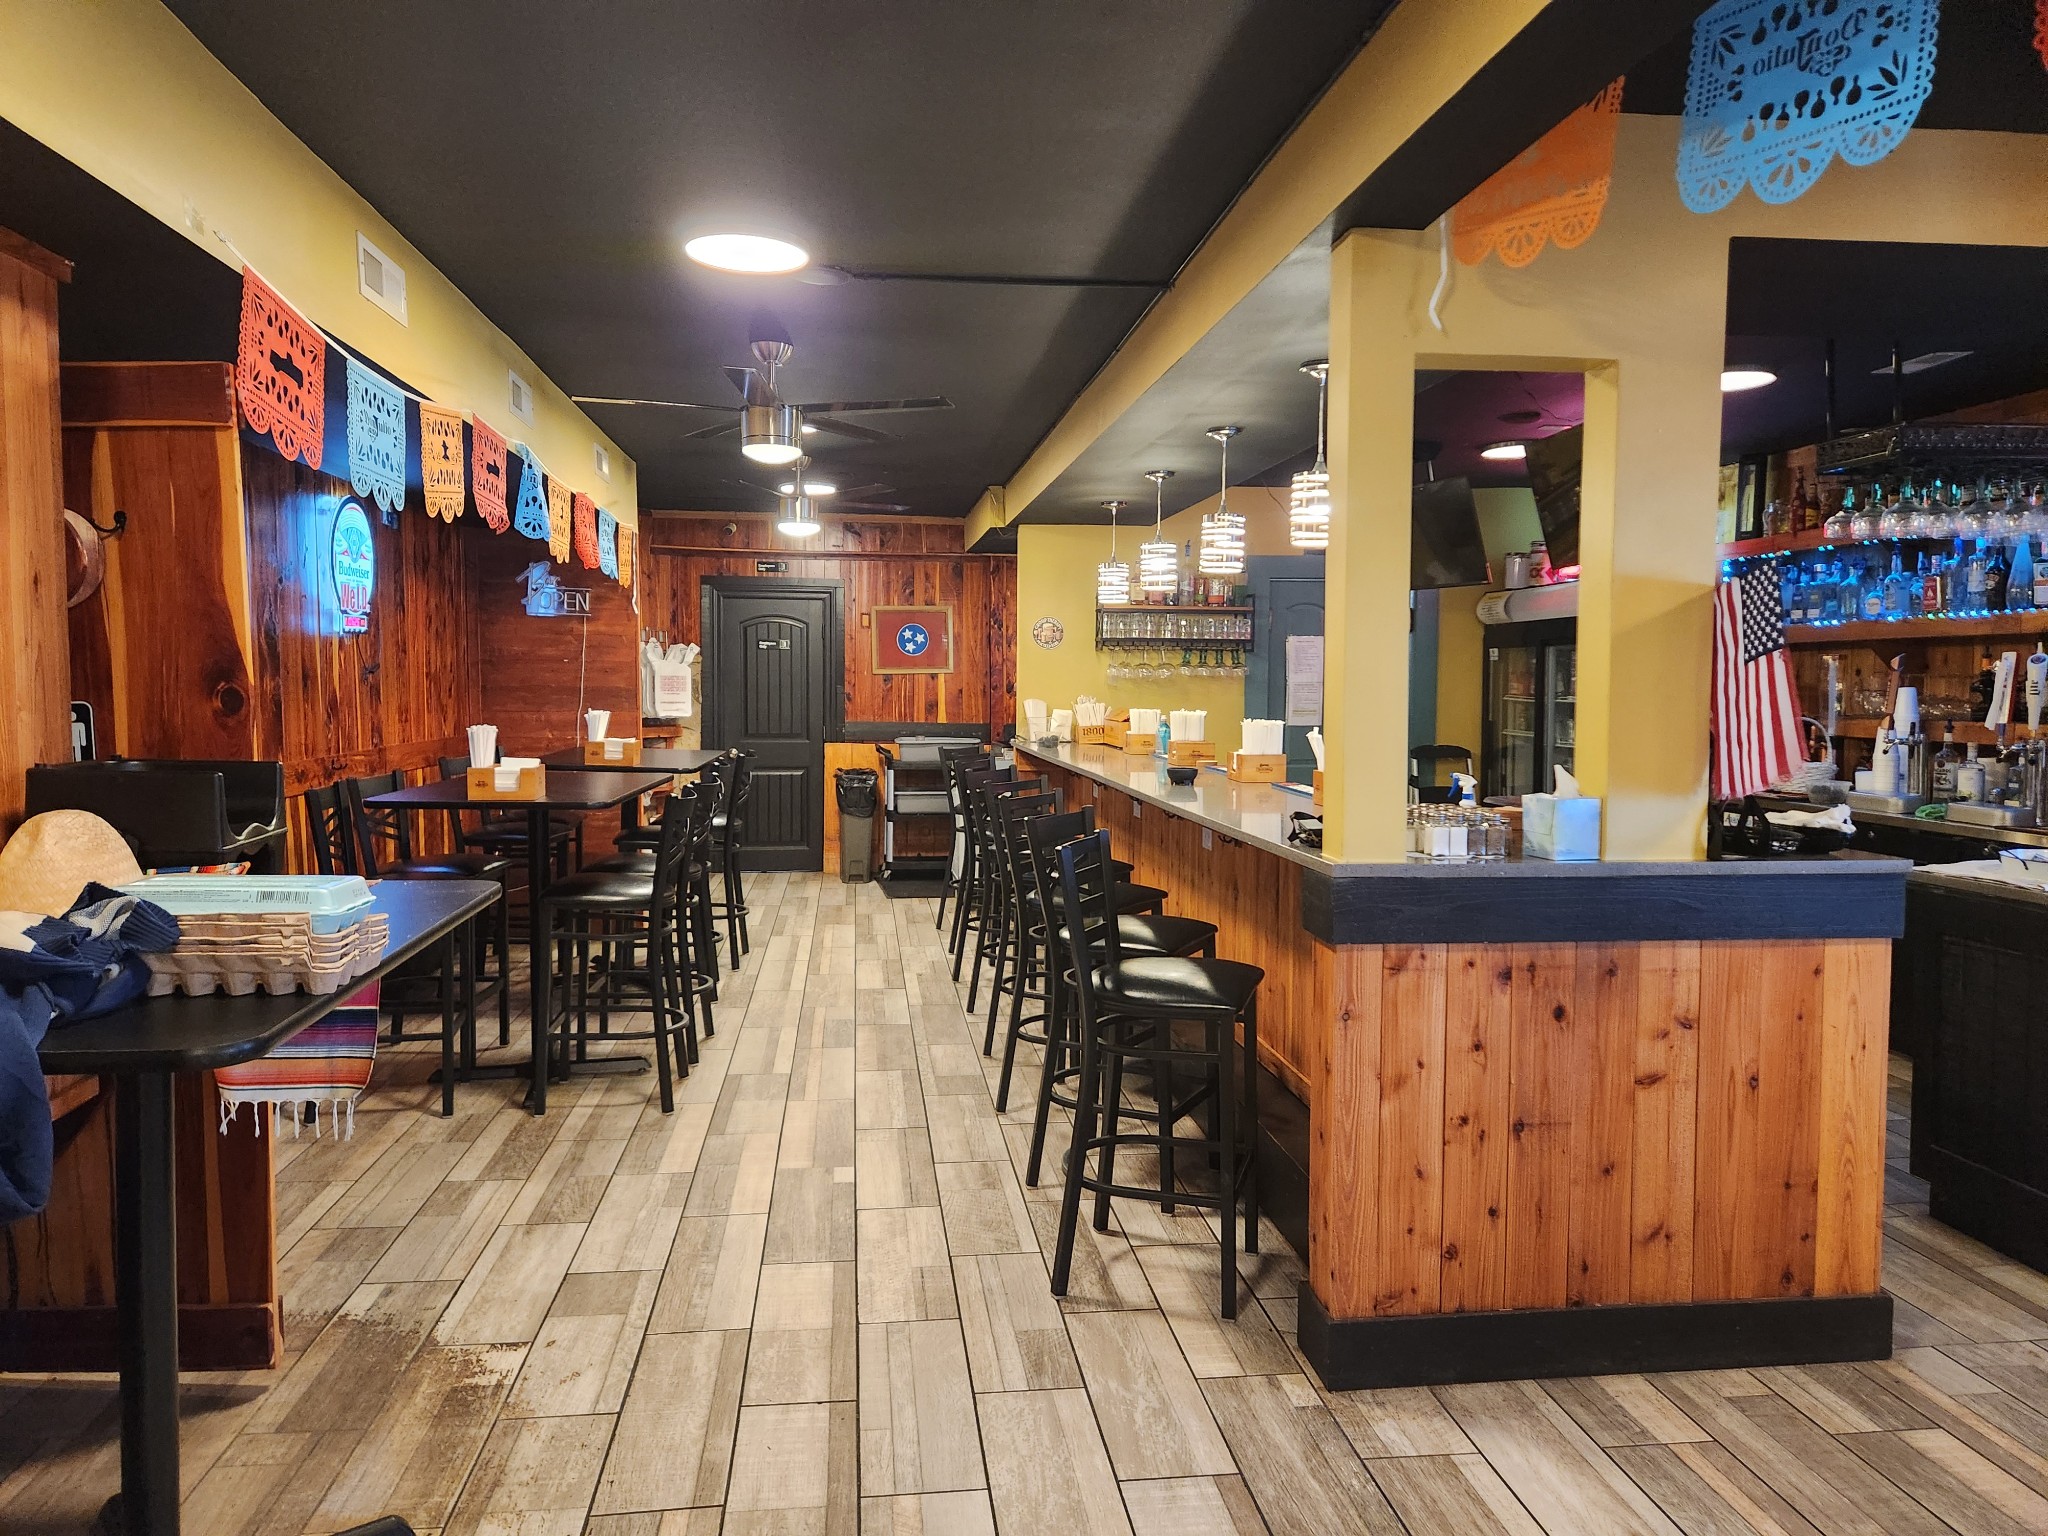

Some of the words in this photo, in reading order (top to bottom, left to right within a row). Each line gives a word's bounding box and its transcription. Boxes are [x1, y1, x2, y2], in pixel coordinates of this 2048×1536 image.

[338, 560, 370, 579] Budweiser
[340, 583, 356, 609] We
[540, 591, 591, 612] OPEN
[1082, 727, 1105, 736] 1800
